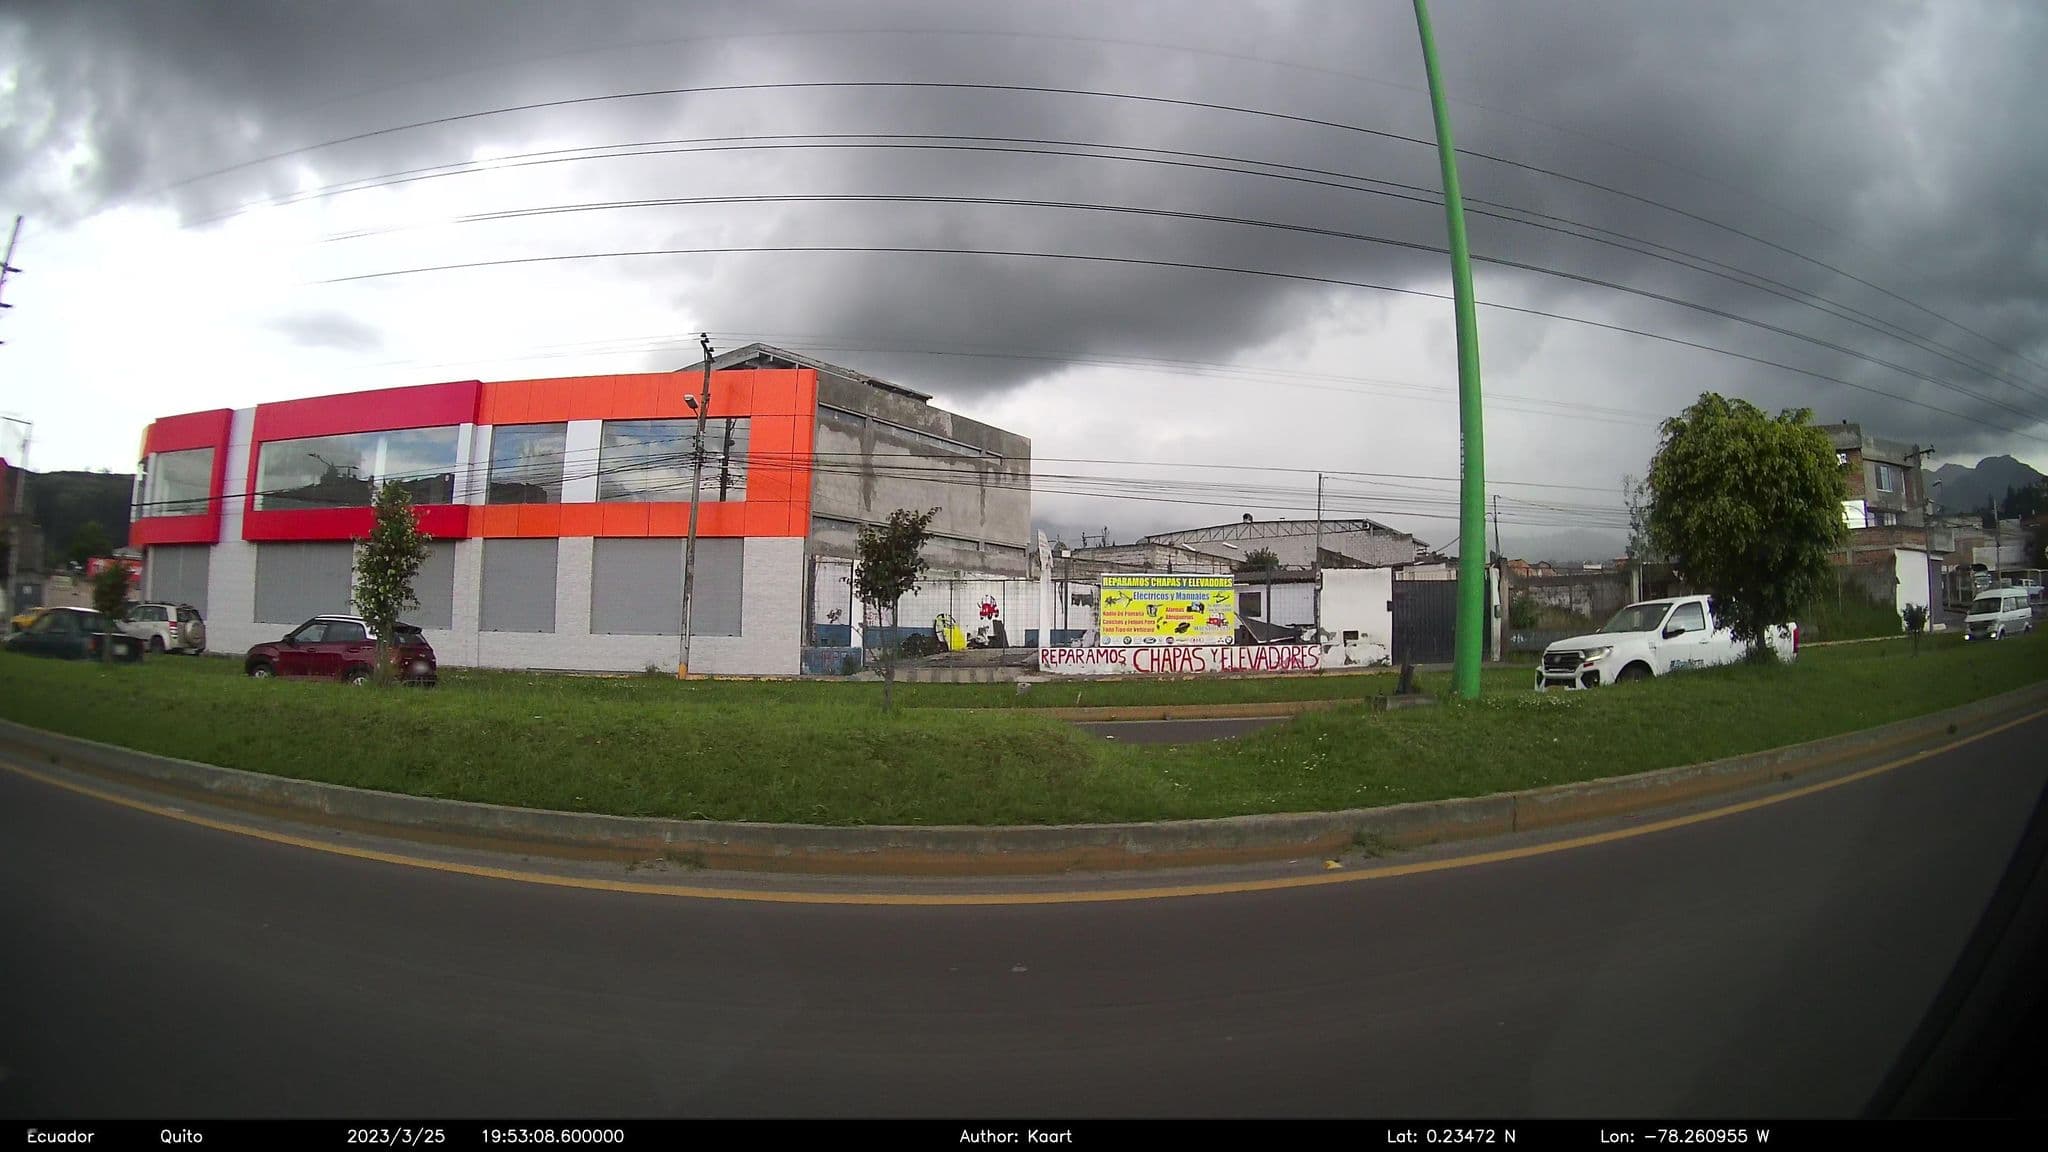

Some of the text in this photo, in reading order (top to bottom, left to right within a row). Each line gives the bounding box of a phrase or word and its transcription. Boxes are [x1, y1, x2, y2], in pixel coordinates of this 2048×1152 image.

[1103, 577, 1233, 587] REPARAMOS CHAPAS Y ELEVADORES
[1170, 593, 1175, 601] y
[1175, 591, 1210, 601] Manuales
[1041, 645, 1319, 672] REPARAMOS CHAPAS Y ELEVADORES
